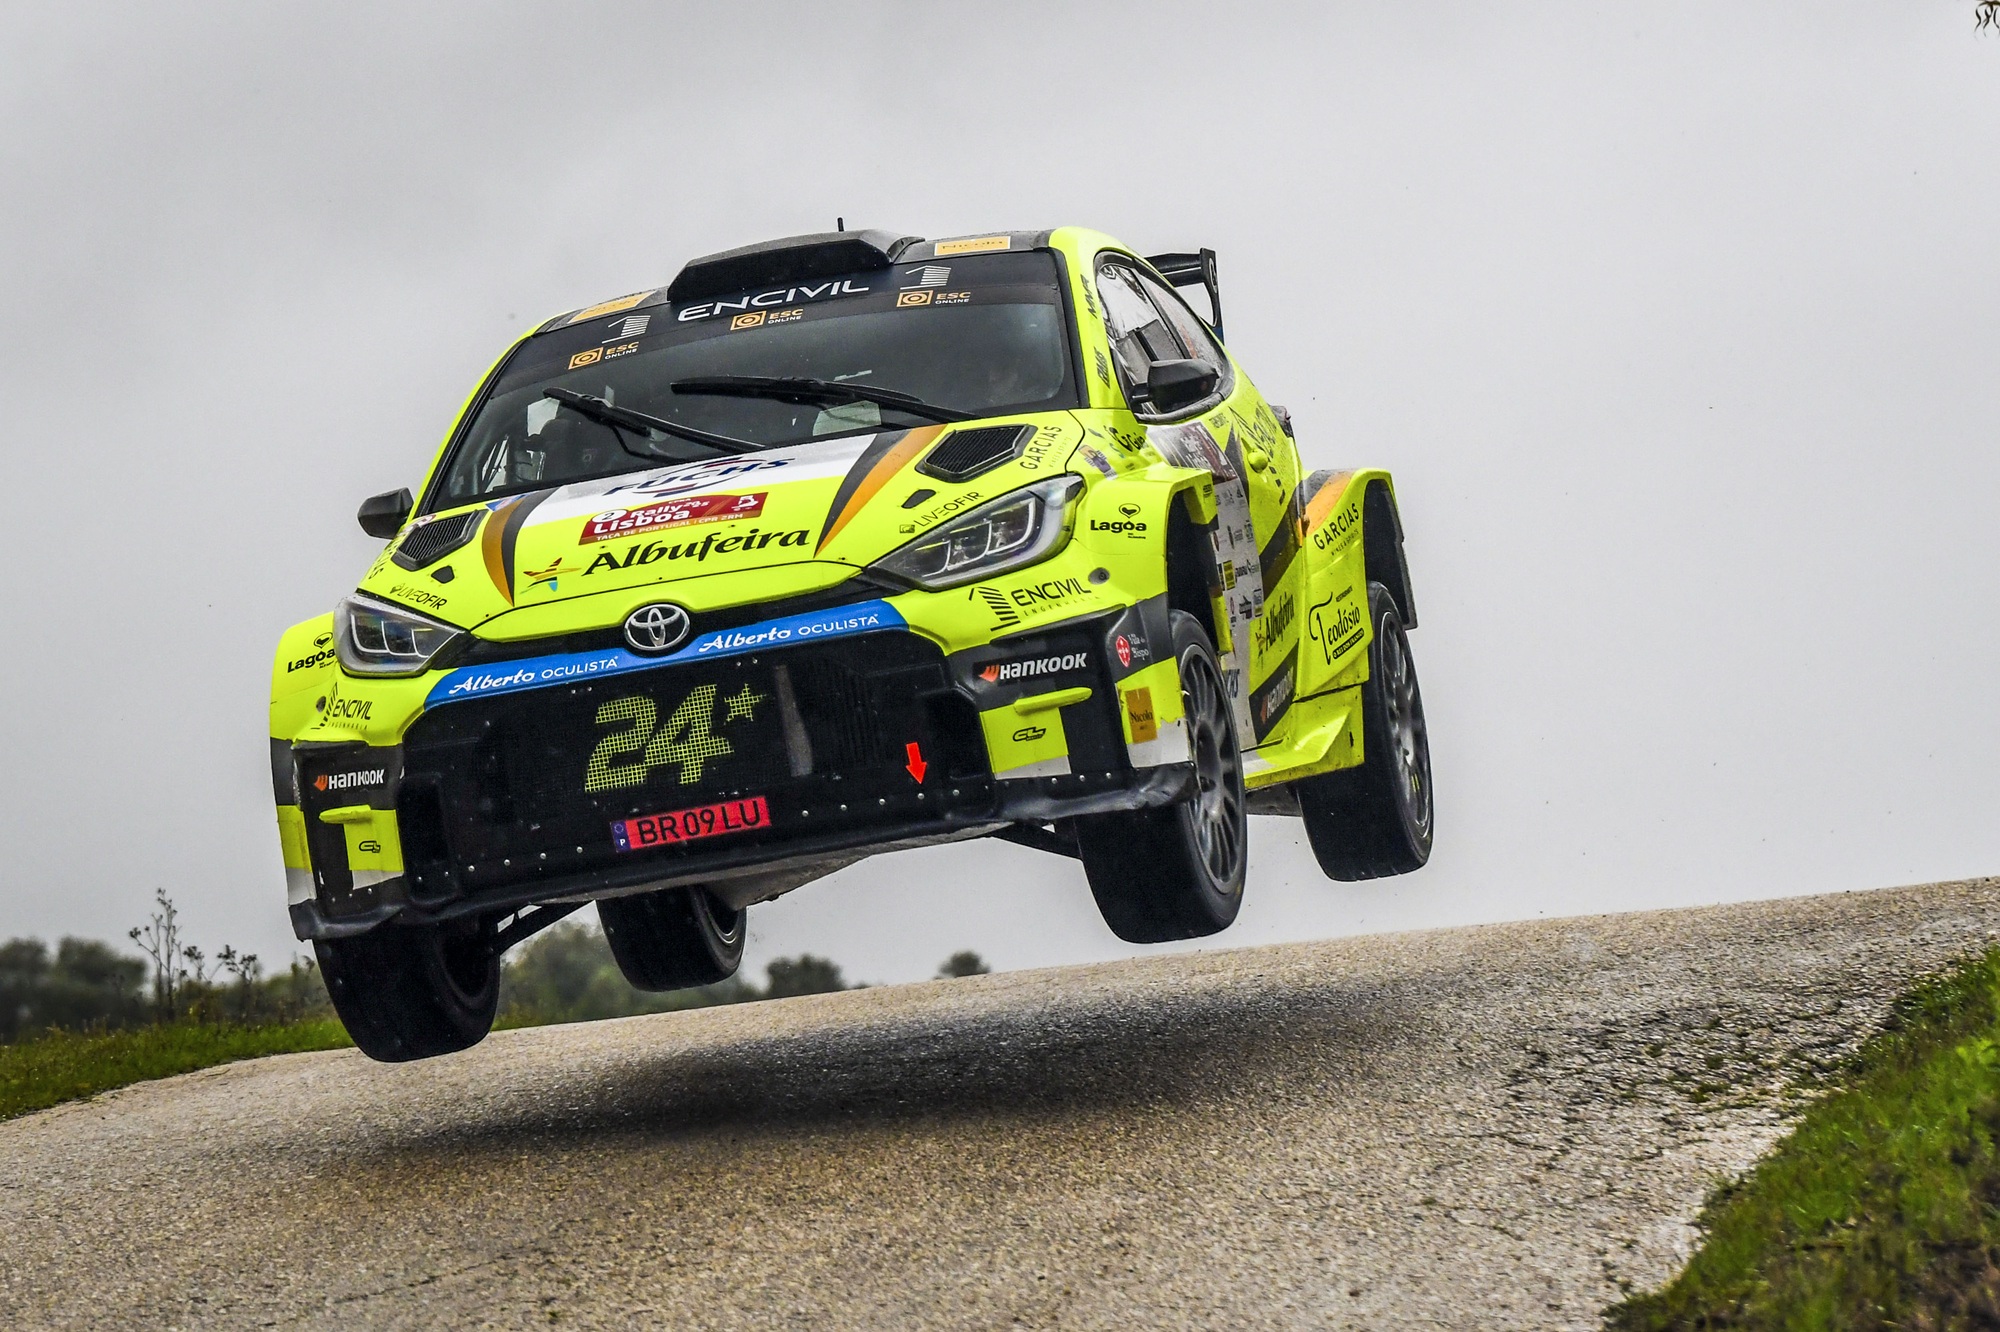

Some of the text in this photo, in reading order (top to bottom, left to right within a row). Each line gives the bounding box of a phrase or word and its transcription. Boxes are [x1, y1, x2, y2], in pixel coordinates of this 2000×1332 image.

[678, 280, 870, 322] ENCIVIL
[936, 291, 971, 300] ESC
[767, 315, 802, 325] ONLINE
[769, 308, 804, 320] ESC
[604, 348, 638, 360] ONLINE
[606, 341, 640, 355] ESC
[1019, 425, 1062, 470] GARCIAS
[602, 457, 796, 497] FUCHS
[594, 509, 691, 534] Lisboa
[601, 511, 611, 521] 2
[630, 504, 683, 520] Rally
[913, 491, 985, 527] LIVEOFIR
[623, 529, 636, 537] DE
[638, 520, 692, 534] PORTUGAL
[699, 516, 719, 524] CPR
[1090, 519, 1147, 534] Lagoa
[1313, 502, 1360, 550] GARCIAS
[581, 527, 811, 577] Albufeira
[1010, 578, 1092, 606] ENCIVIL
[699, 616, 880, 652] Alberto OCULISTA
[1308, 591, 1361, 666] Teodósio
[287, 648, 336, 673] Lagoa
[449, 658, 618, 694] Alberto OCULISTA
[332, 699, 373, 720] ENCIVIL
[584, 683, 735, 793] 24
[619, 838, 626, 846] P
